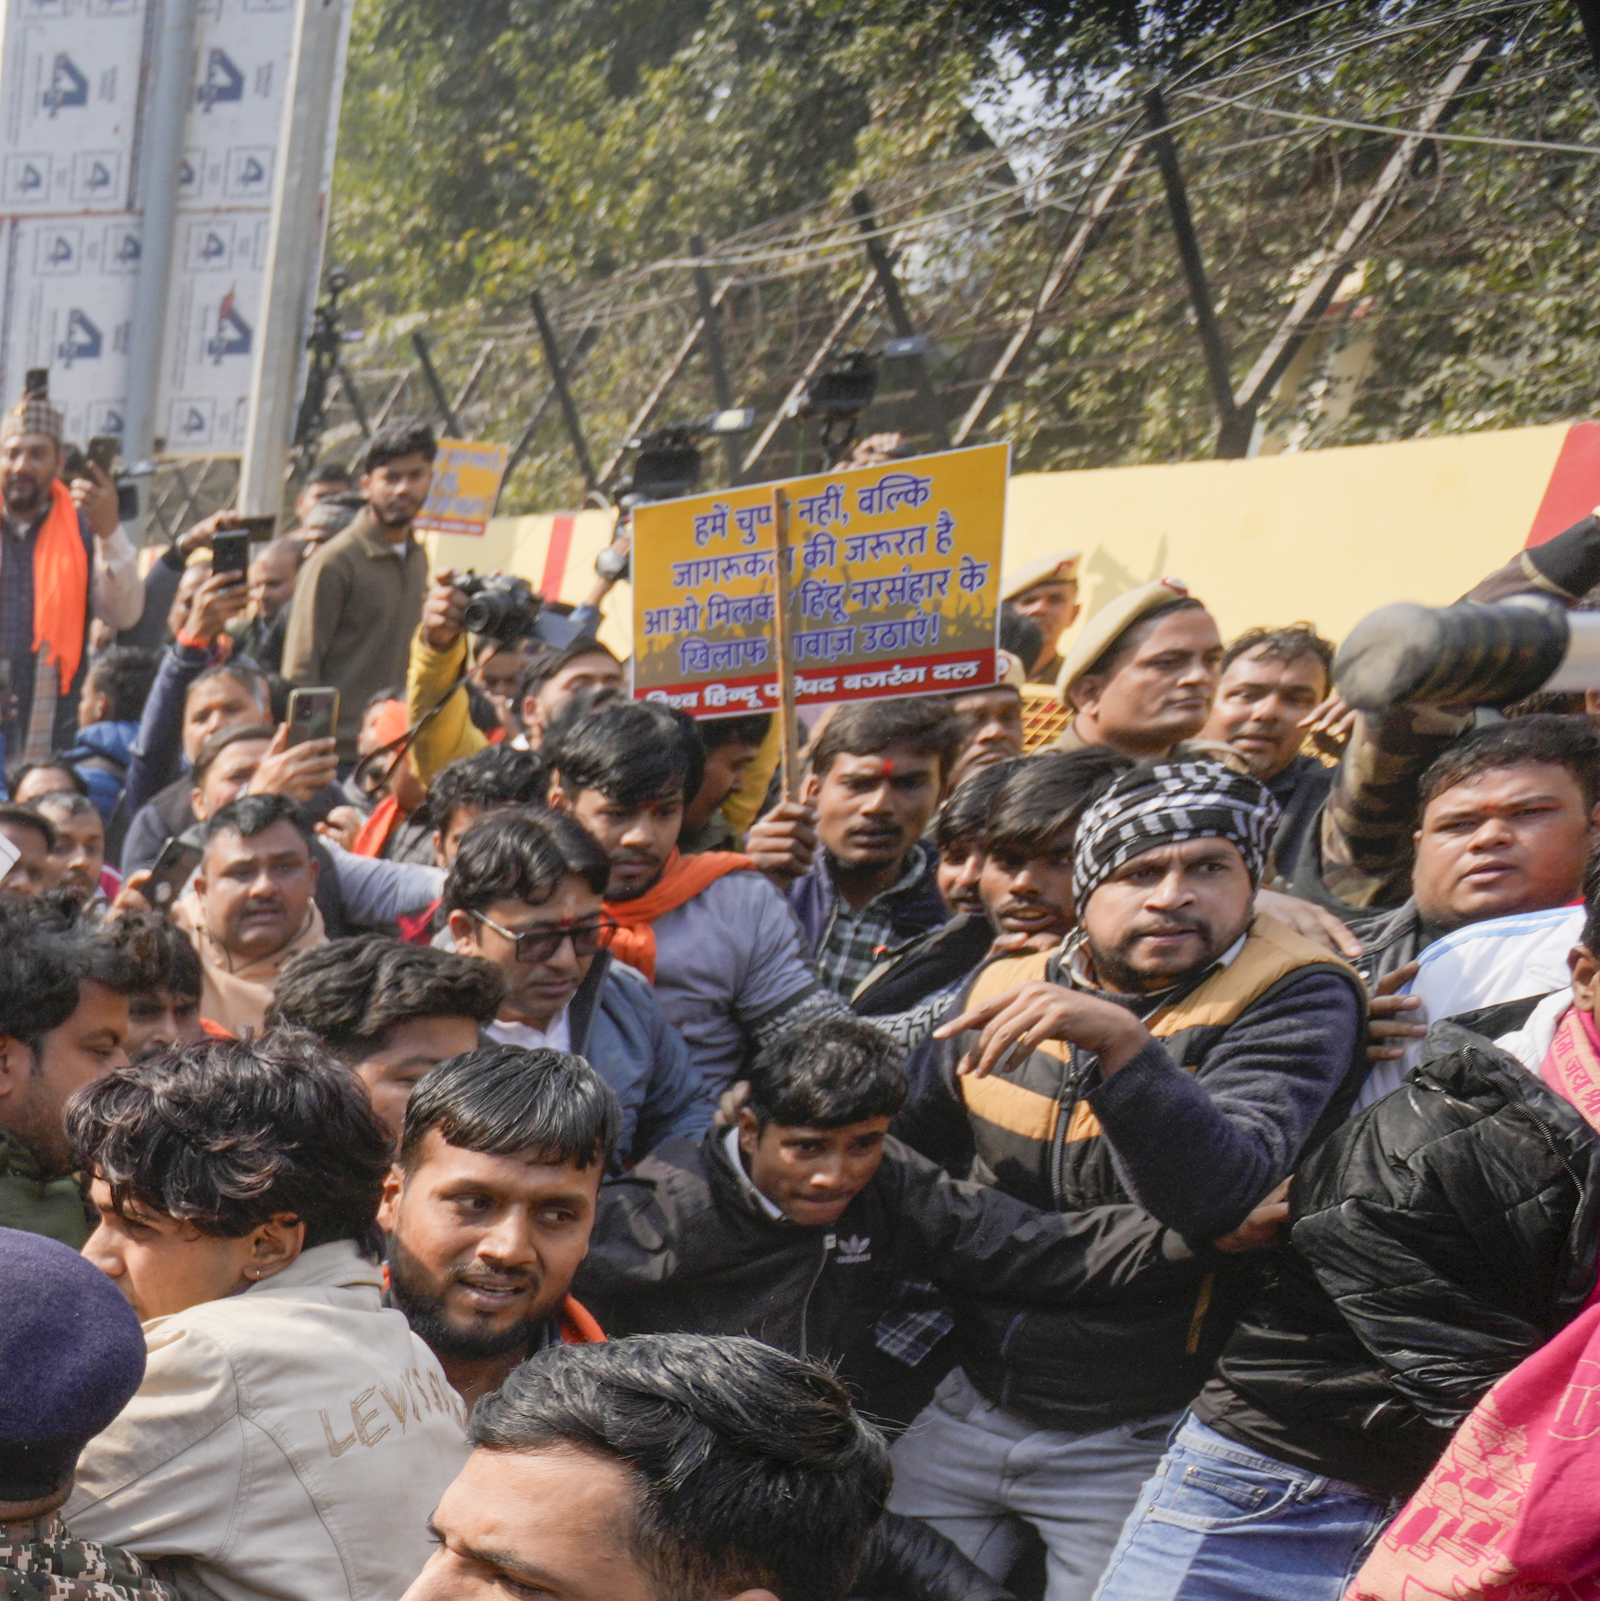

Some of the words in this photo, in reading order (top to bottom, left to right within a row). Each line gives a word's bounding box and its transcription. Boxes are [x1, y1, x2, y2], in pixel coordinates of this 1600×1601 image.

[694, 502, 730, 547] हमें
[798, 483, 849, 527] नहीं,
[803, 531, 838, 569] की
[843, 524, 930, 563] जरूरत
[935, 509, 956, 555] है
[643, 594, 702, 636] आओ
[707, 590, 795, 629] मिलक
[801, 577, 849, 623] हिंदू
[851, 564, 953, 609] नरसंहार
[958, 555, 990, 593] के
[680, 636, 770, 676] खिलाफ
[932, 660, 981, 680] दल
[1565, 1055, 1595, 1094] जय
